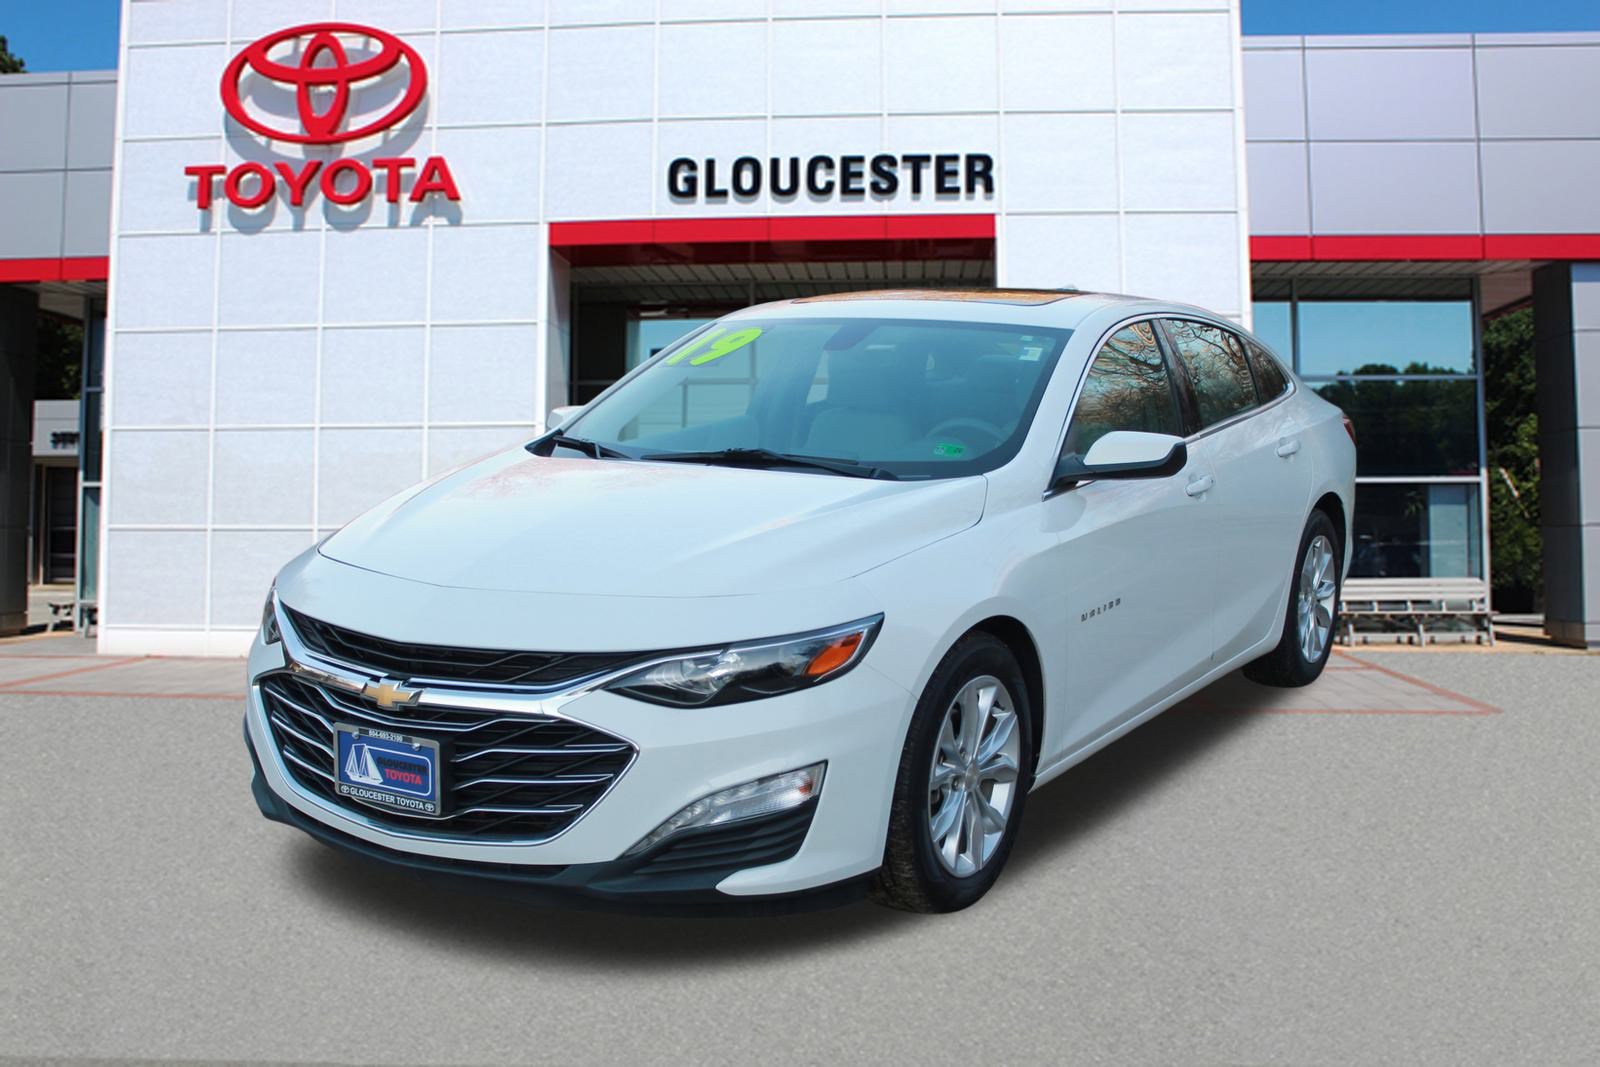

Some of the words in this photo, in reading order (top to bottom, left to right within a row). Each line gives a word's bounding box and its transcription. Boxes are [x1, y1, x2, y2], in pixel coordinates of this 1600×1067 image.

[185, 156, 461, 209] TOYOTA
[668, 154, 994, 198] GLOUCESTER
[384, 768, 422, 785] TOYOTA
[350, 786, 395, 804] GLOUCESTER
[396, 797, 424, 810] TOYOTA
